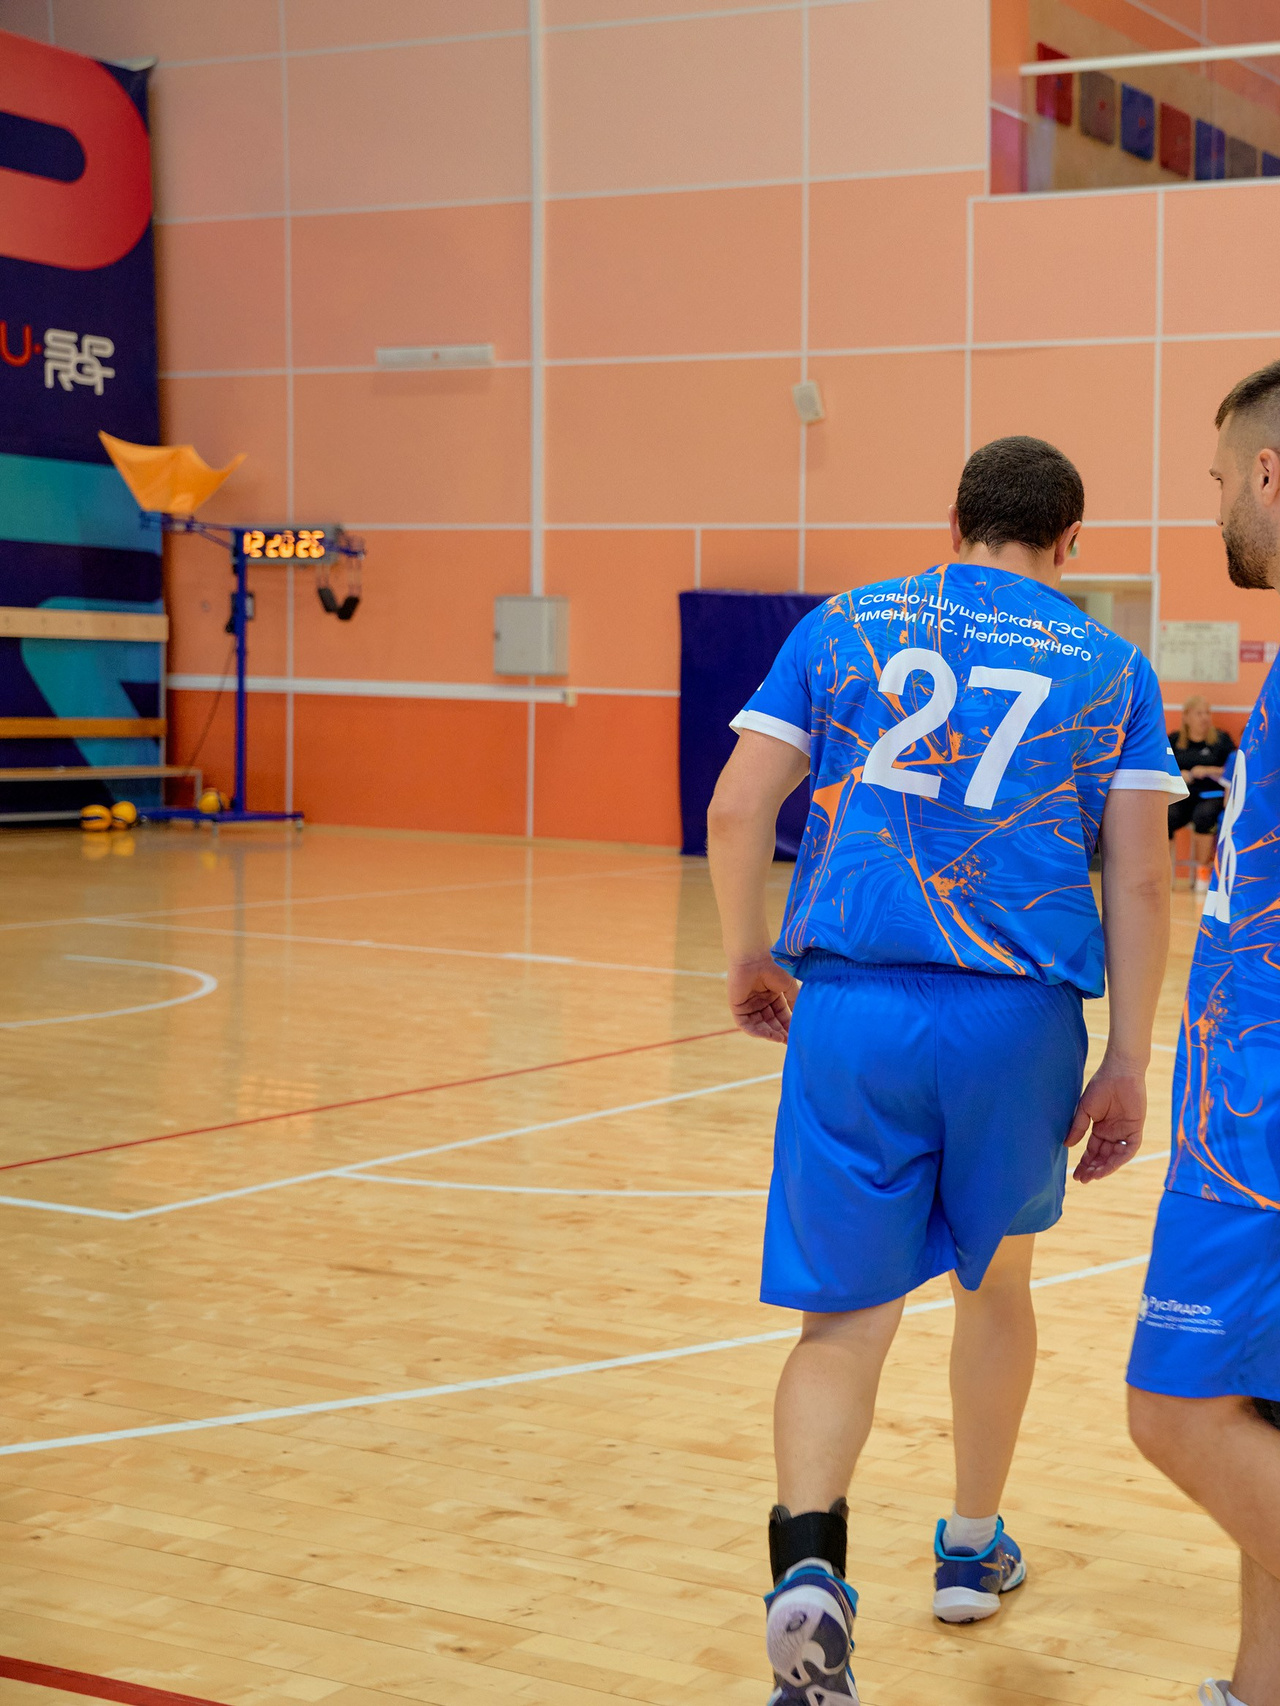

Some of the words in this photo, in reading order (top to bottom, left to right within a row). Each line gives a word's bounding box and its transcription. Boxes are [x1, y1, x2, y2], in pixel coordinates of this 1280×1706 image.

[854, 608, 917, 624] имени
[921, 612, 958, 637] П.С.
[963, 624, 1092, 662] Непорожнего
[859, 592, 1043, 631] Саяно-Шушенская
[1047, 620, 1086, 639] ГЭС
[862, 648, 1052, 811] 27
